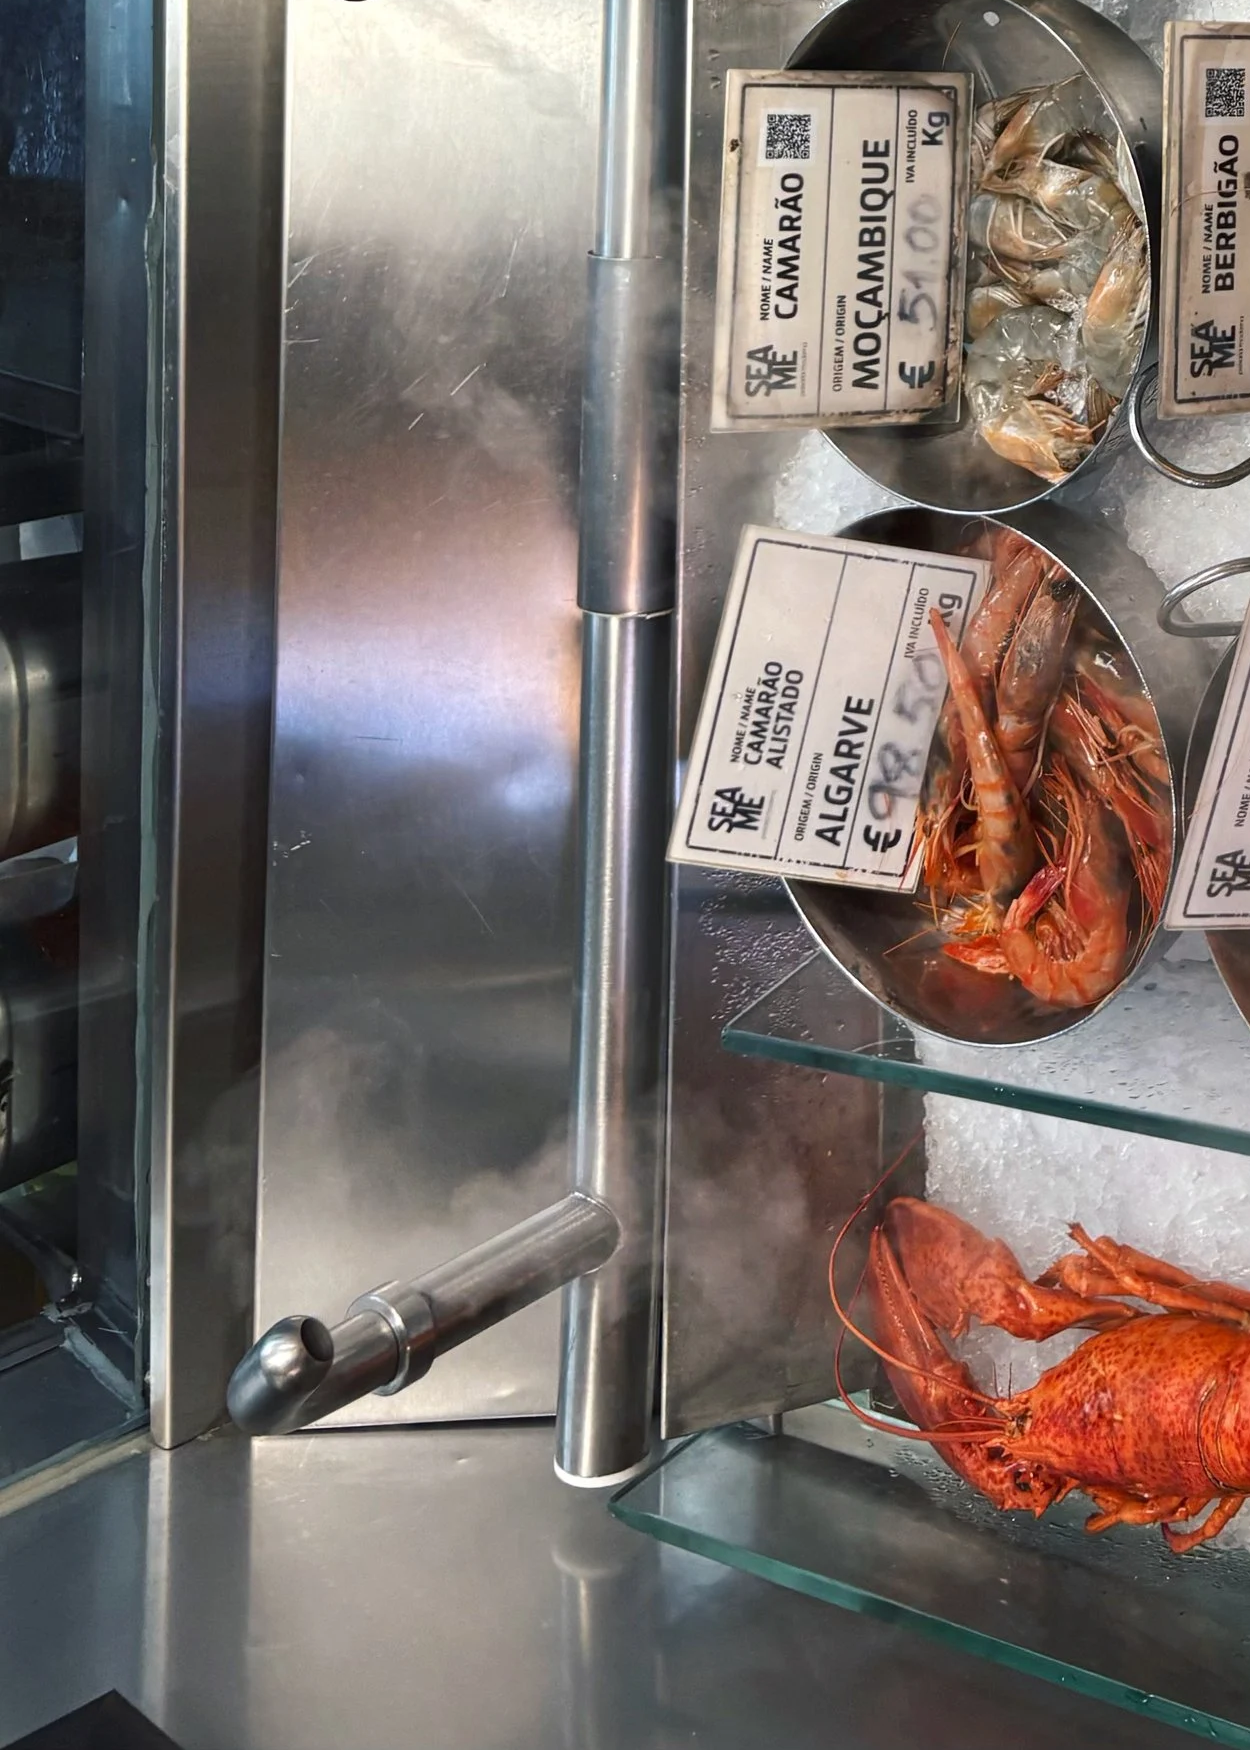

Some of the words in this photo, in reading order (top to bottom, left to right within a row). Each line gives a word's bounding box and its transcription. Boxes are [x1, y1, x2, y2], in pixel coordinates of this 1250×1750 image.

[905, 109, 918, 163] INCLUÍDO
[922, 110, 951, 147] Kg
[905, 165, 915, 183] IVA
[1203, 204, 1213, 243] NAME
[1212, 134, 1239, 292] BERBIGÃO
[762, 238, 774, 274] NAME
[770, 173, 804, 319] CAMARÃO
[851, 138, 895, 391] MOÇAMBIQUE
[1201, 254, 1212, 294] NOME
[760, 285, 771, 321] NOME
[835, 295, 847, 336] ORIGIN
[767, 347, 798, 391] ME
[832, 346, 844, 392] ORIGEM
[1190, 319, 1217, 378] SEA
[1208, 322, 1236, 370] ME
[744, 344, 776, 397] SEA
[897, 358, 935, 389] €
[908, 588, 929, 639] INCLUÍDO
[904, 641, 917, 659] IVA
[730, 730, 746, 763] NOME
[740, 687, 756, 721] NAME
[737, 661, 783, 765] CAMARÃO
[765, 670, 804, 770] ALISTADO
[815, 696, 875, 847] ALGARVE
[707, 787, 744, 834] SEA
[730, 793, 765, 831] ME
[794, 799, 813, 841] ORIGEM
[806, 752, 823, 791] ORIGIN
[863, 824, 902, 853] €
[1206, 849, 1245, 898] SEA
